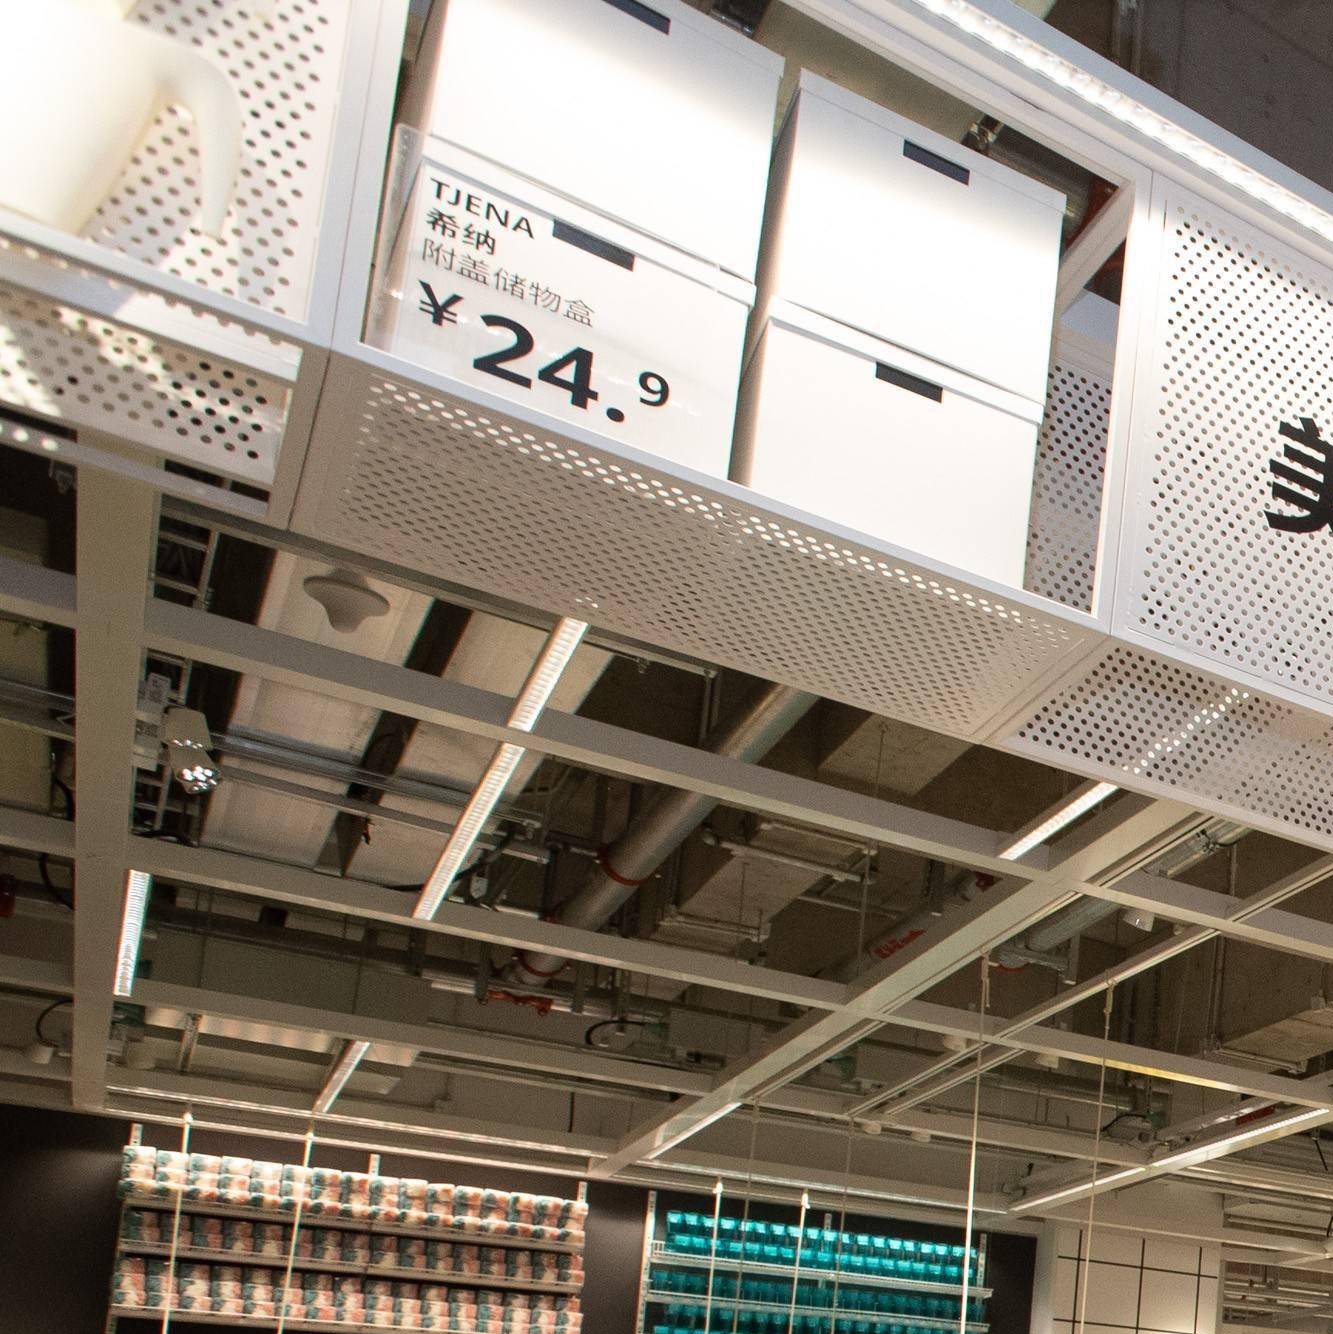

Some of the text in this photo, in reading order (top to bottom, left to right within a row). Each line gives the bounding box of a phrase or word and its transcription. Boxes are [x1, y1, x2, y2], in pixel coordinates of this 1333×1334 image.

[426, 207, 497, 255] 希纳
[431, 177, 534, 239] TJENA
[422, 237, 595, 328] 附盖储物盒
